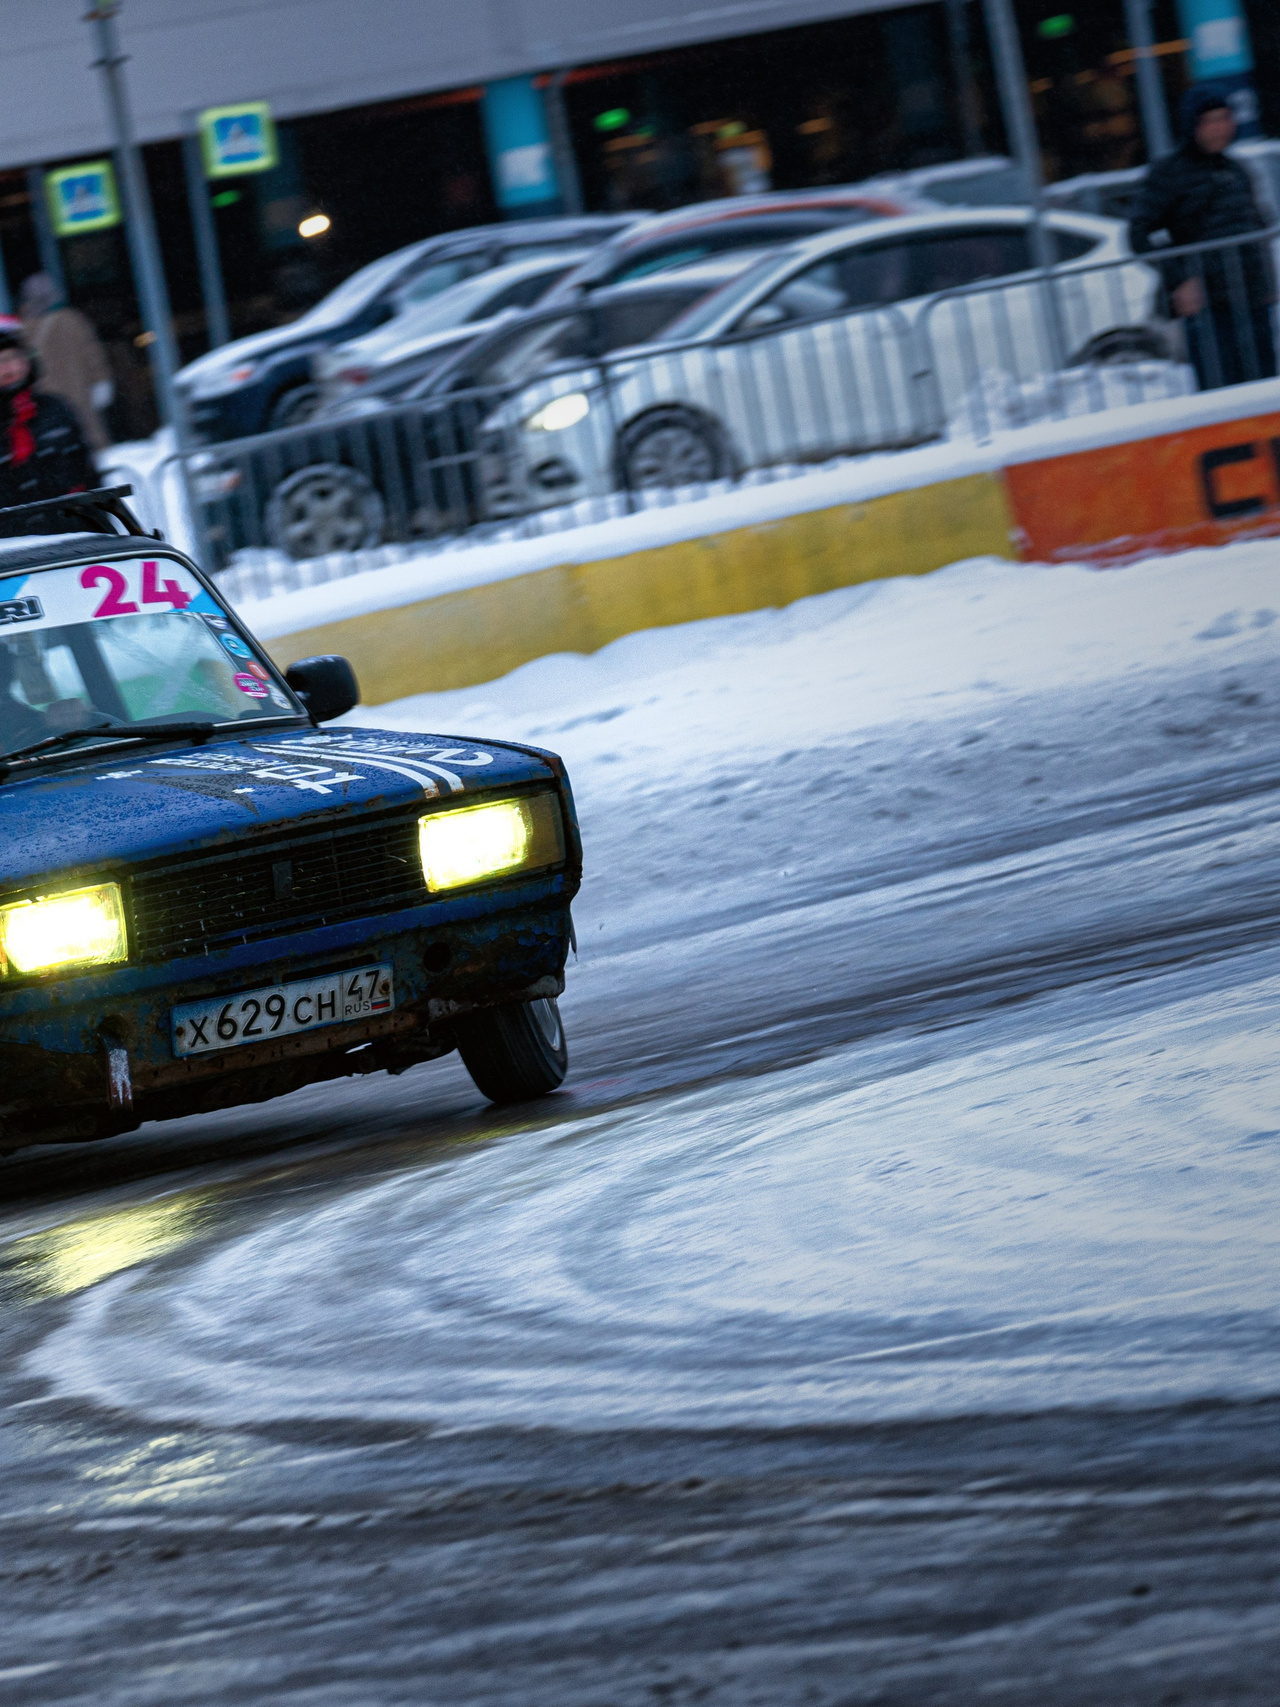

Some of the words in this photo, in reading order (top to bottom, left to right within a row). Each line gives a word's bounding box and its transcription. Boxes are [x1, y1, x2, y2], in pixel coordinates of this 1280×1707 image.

[80, 560, 192, 618] 24
[347, 969, 381, 1001] 47
[344, 1000, 371, 1016] RUS
